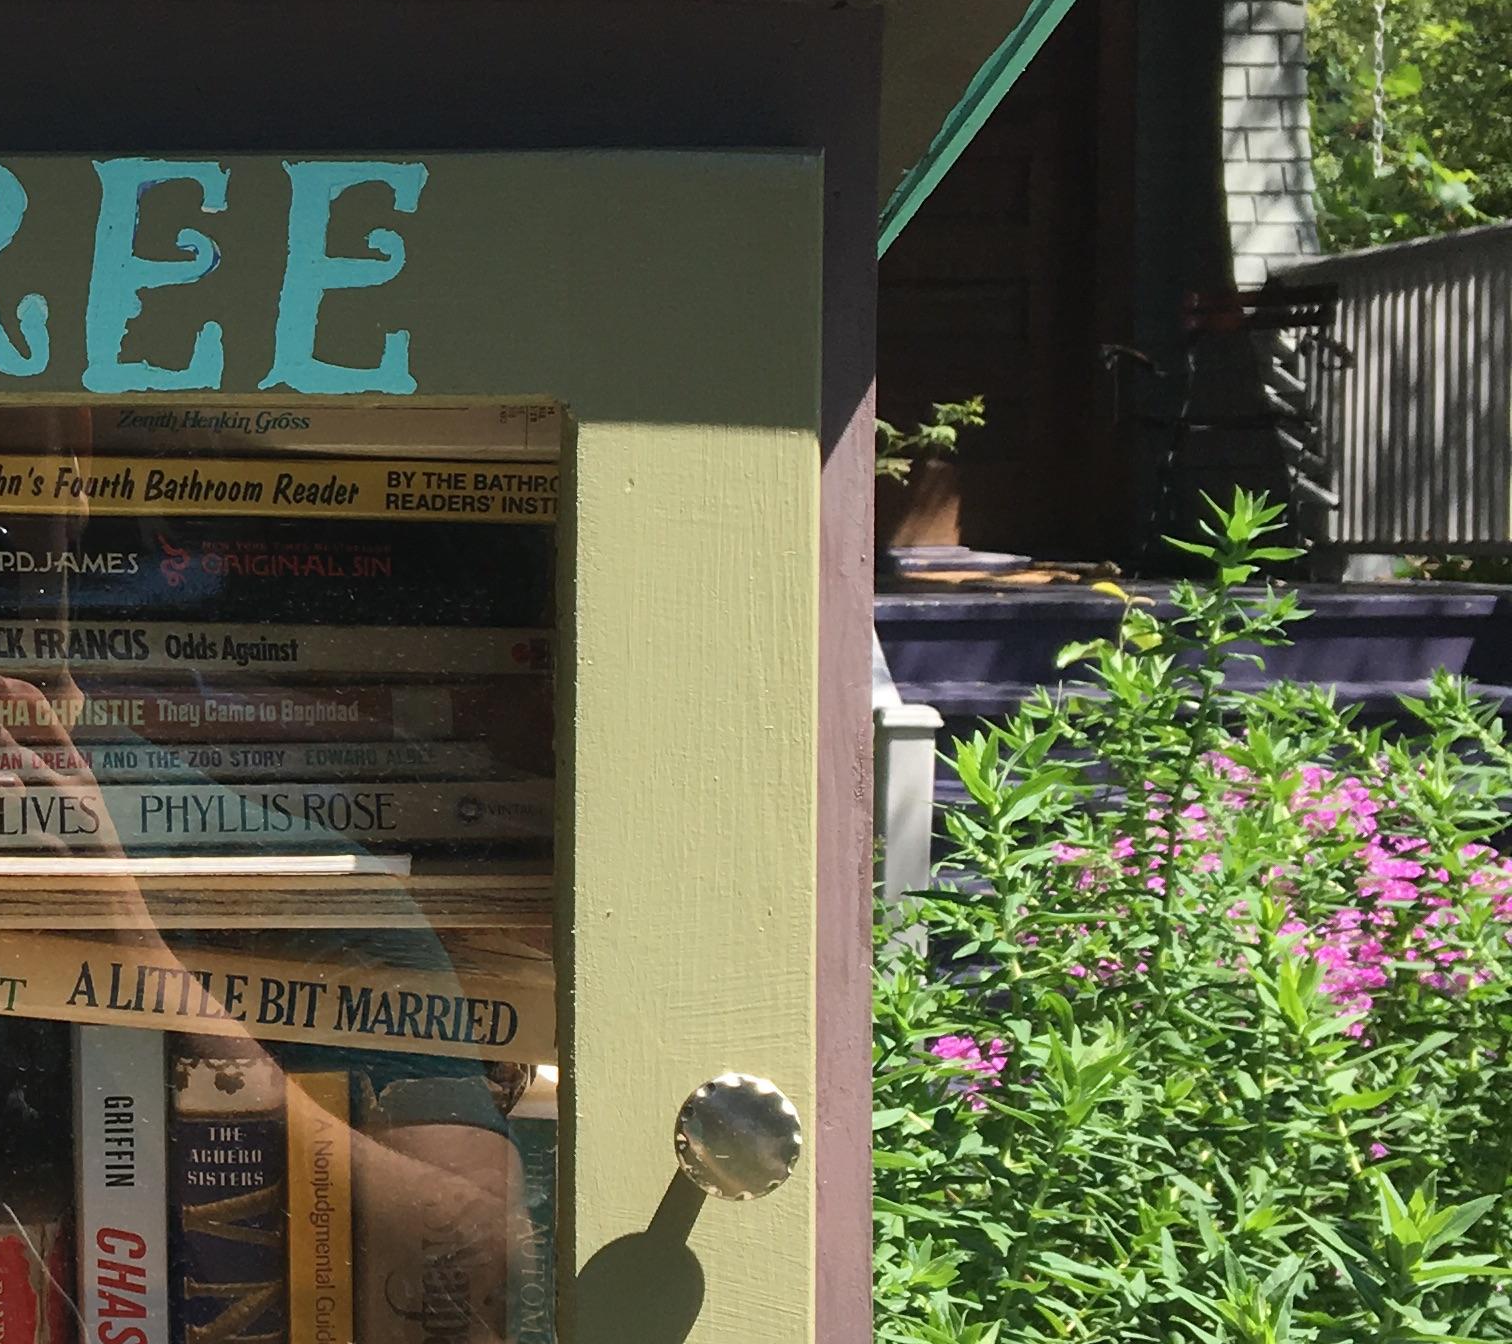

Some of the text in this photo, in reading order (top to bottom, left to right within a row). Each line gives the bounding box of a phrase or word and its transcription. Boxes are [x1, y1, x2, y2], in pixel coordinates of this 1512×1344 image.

[118, 409, 311, 434] Zenith Henkin Gross
[54, 466, 136, 500] Fourth
[144, 468, 263, 504] Bathroom
[273, 473, 359, 506] Reader
[388, 470, 415, 490] BY
[425, 472, 467, 491] THE
[387, 493, 495, 513] READERS'
[201, 554, 393, 578] ORIGINAL SIN
[35, 628, 150, 662] FRANCIS
[165, 633, 218, 661] Odds
[222, 635, 299, 666] Against
[35, 698, 145, 728] CHRISTIE
[157, 699, 201, 727] They
[205, 698, 256, 723] Came
[259, 699, 278, 723] to
[282, 699, 360, 727] Baghdad
[31, 751, 94, 770] DREAM
[102, 751, 139, 769] AND
[147, 751, 180, 769] THE
[187, 750, 223, 768] ZOO
[229, 750, 286, 768] STORY
[304, 748, 378, 767] EDWARD
[139, 793, 294, 834] PHYLLIS
[303, 791, 397, 832] ROSE
[66, 960, 520, 1046] A LITTLE BIT MARRIED
[103, 1094, 136, 1189] GRIFFIN
[207, 1126, 245, 1143] THE
[186, 1170, 265, 1187] SISTERS
[308, 1139, 336, 1291] Nonjudgmental
